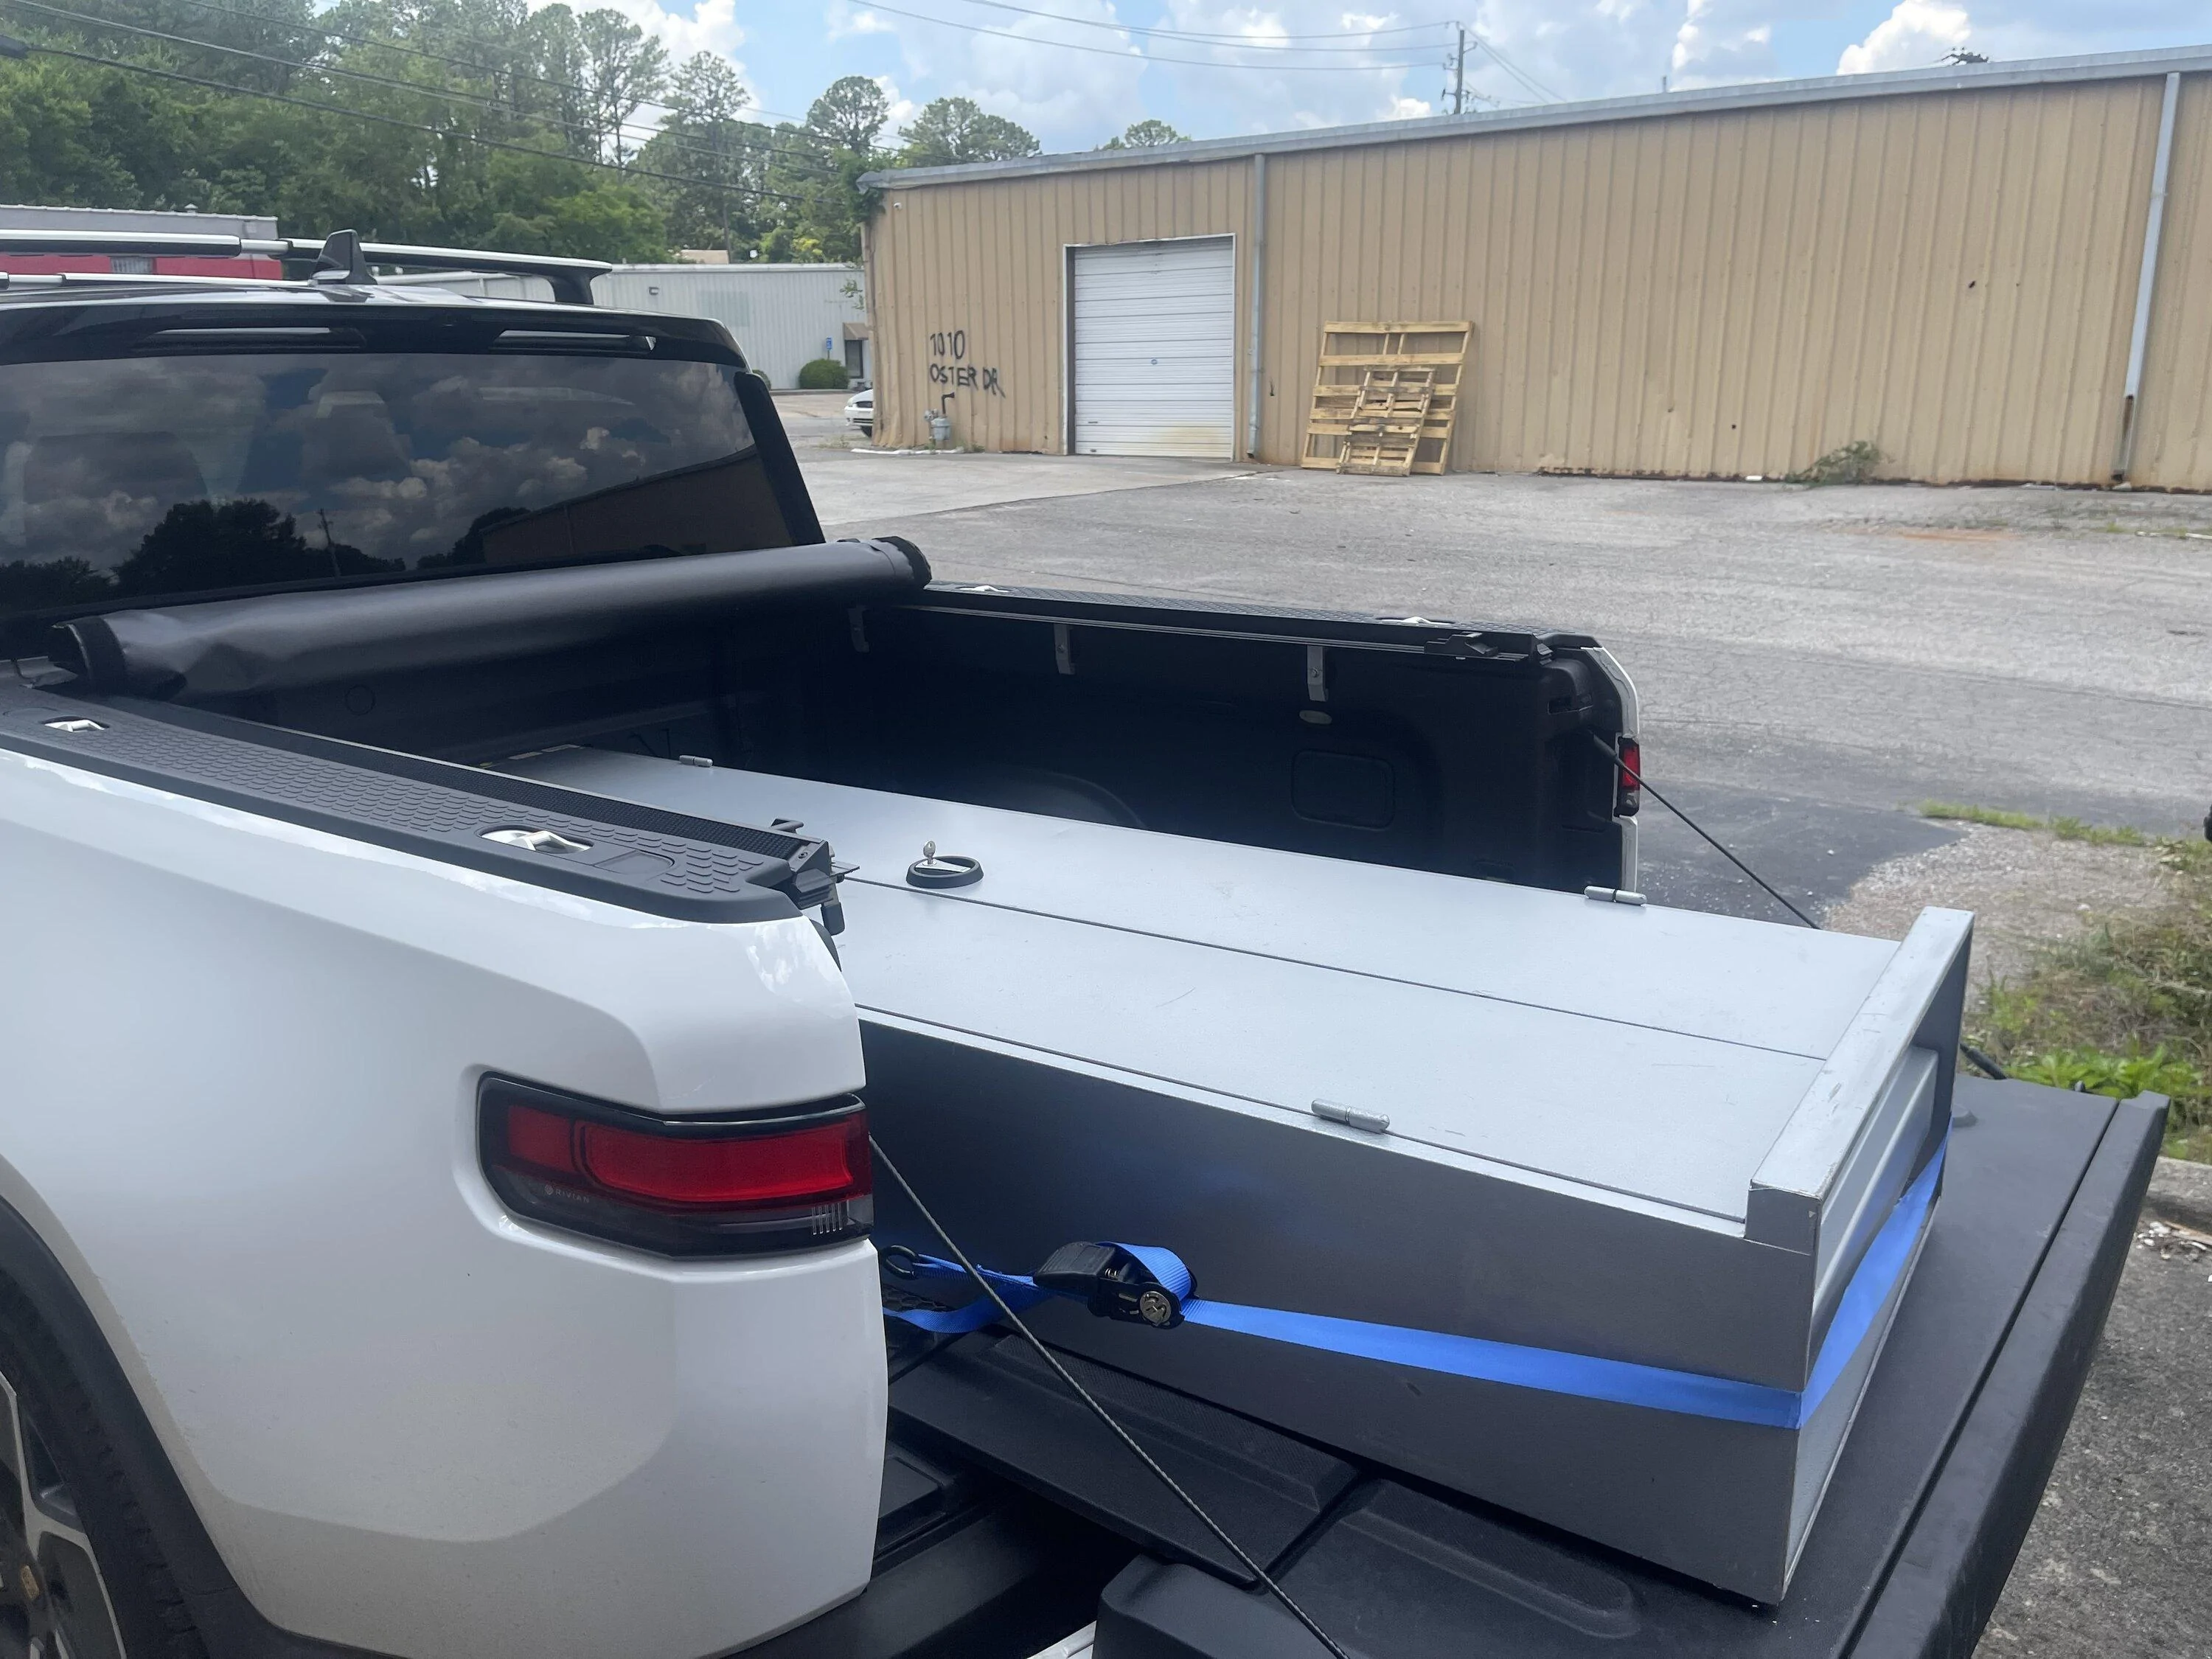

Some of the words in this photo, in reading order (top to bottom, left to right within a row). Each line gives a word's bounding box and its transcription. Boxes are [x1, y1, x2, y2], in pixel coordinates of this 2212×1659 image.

[930, 330, 965, 360] 1010
[930, 364, 978, 390] OSTER
[983, 367, 1006, 398] DR
[556, 1188, 589, 1203] RIVIAN
